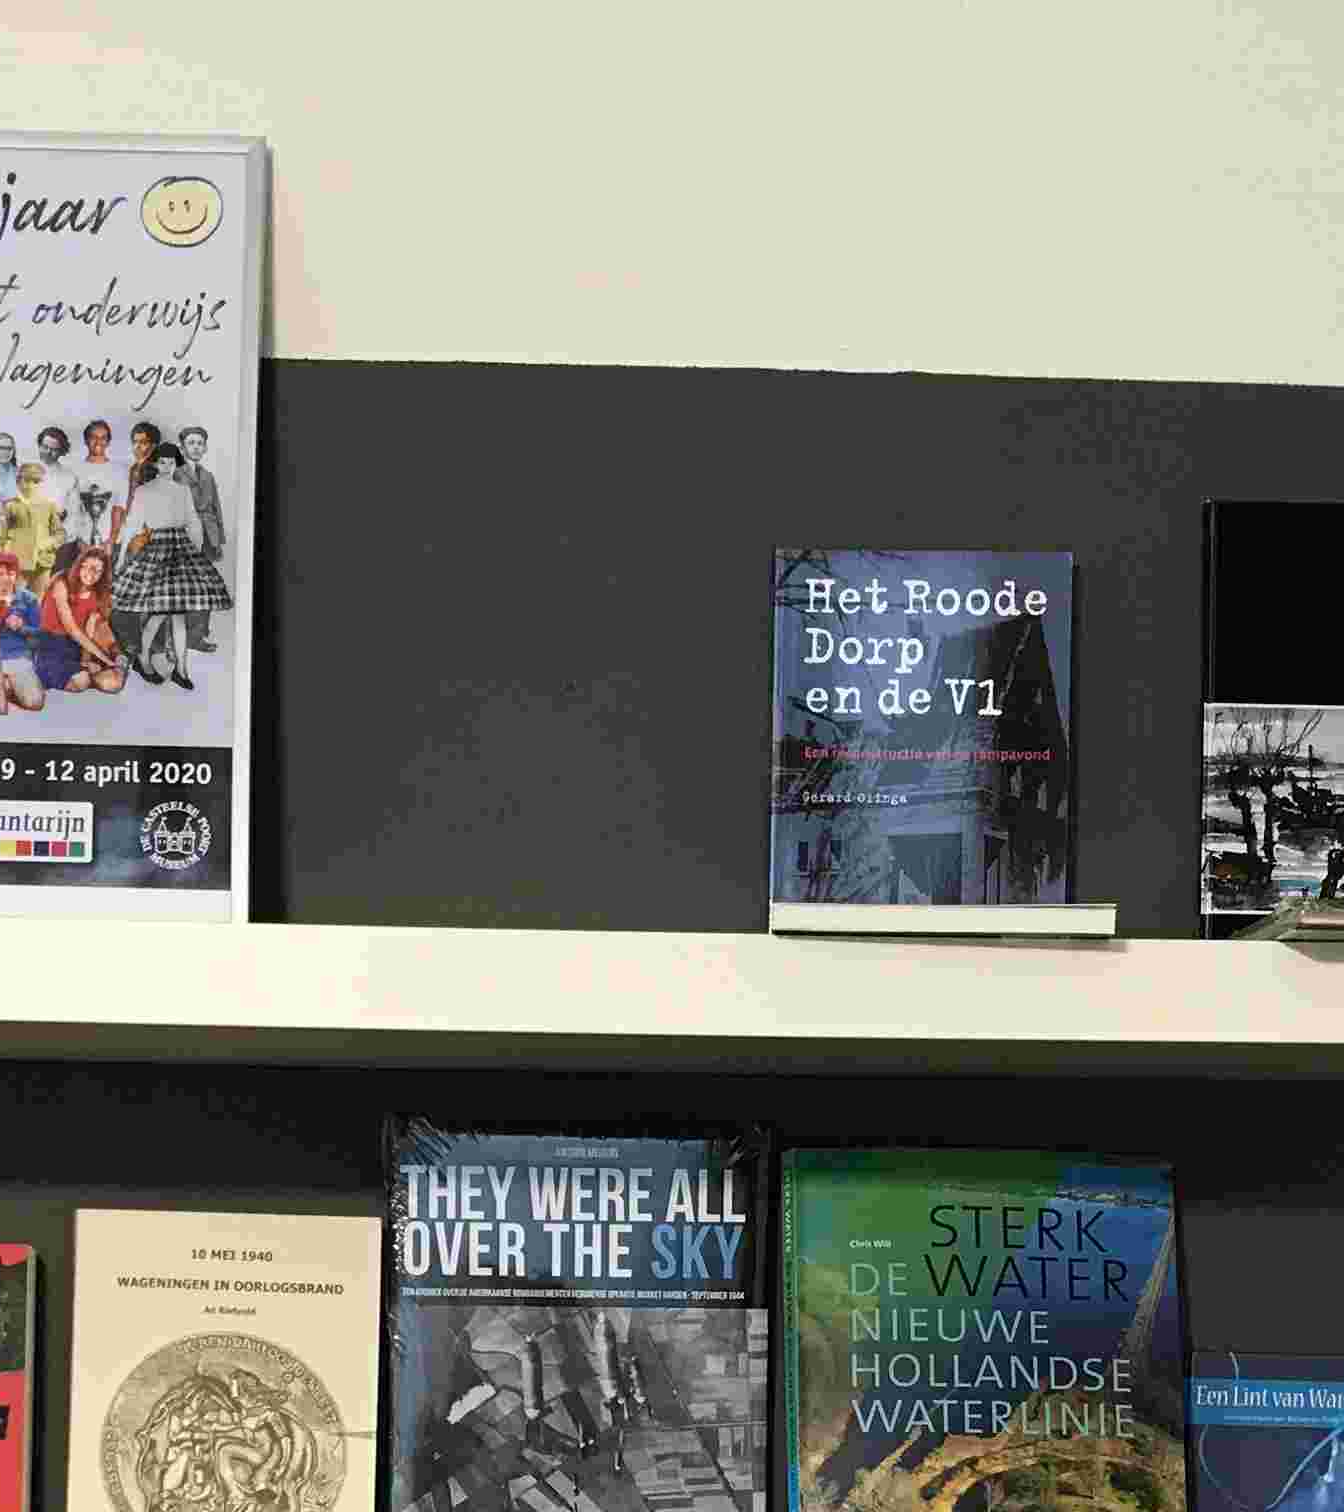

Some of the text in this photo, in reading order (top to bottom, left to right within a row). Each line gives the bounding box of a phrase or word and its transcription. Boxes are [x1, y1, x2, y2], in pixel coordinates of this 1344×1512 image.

[32, 276, 227, 359] onderwijs
[805, 578, 1048, 616] Het Roode
[804, 627, 925, 672] Dorp
[805, 678, 1002, 717] en de V1
[44, 760, 74, 783] 12
[83, 761, 140, 788] april
[149, 762, 212, 785] 2020
[400, 1165, 745, 1223] THEY WERE ALL
[930, 1203, 1106, 1252] STERK
[191, 1249, 273, 1263] 10 MEI 1940
[402, 1221, 744, 1280] OVER THE SKY
[117, 1277, 344, 1295] WAGENINGEN IN OORLOGSBRAND
[849, 1253, 1129, 1302] DE WATER
[850, 1308, 1049, 1344] NIEUWE
[850, 1353, 1132, 1393] HOLLANDSE
[1196, 1386, 1227, 1407] Een
[1234, 1387, 1268, 1408] Lint
[1272, 1393, 1307, 1409] van
[849, 1399, 1135, 1437] WATERLINIE
